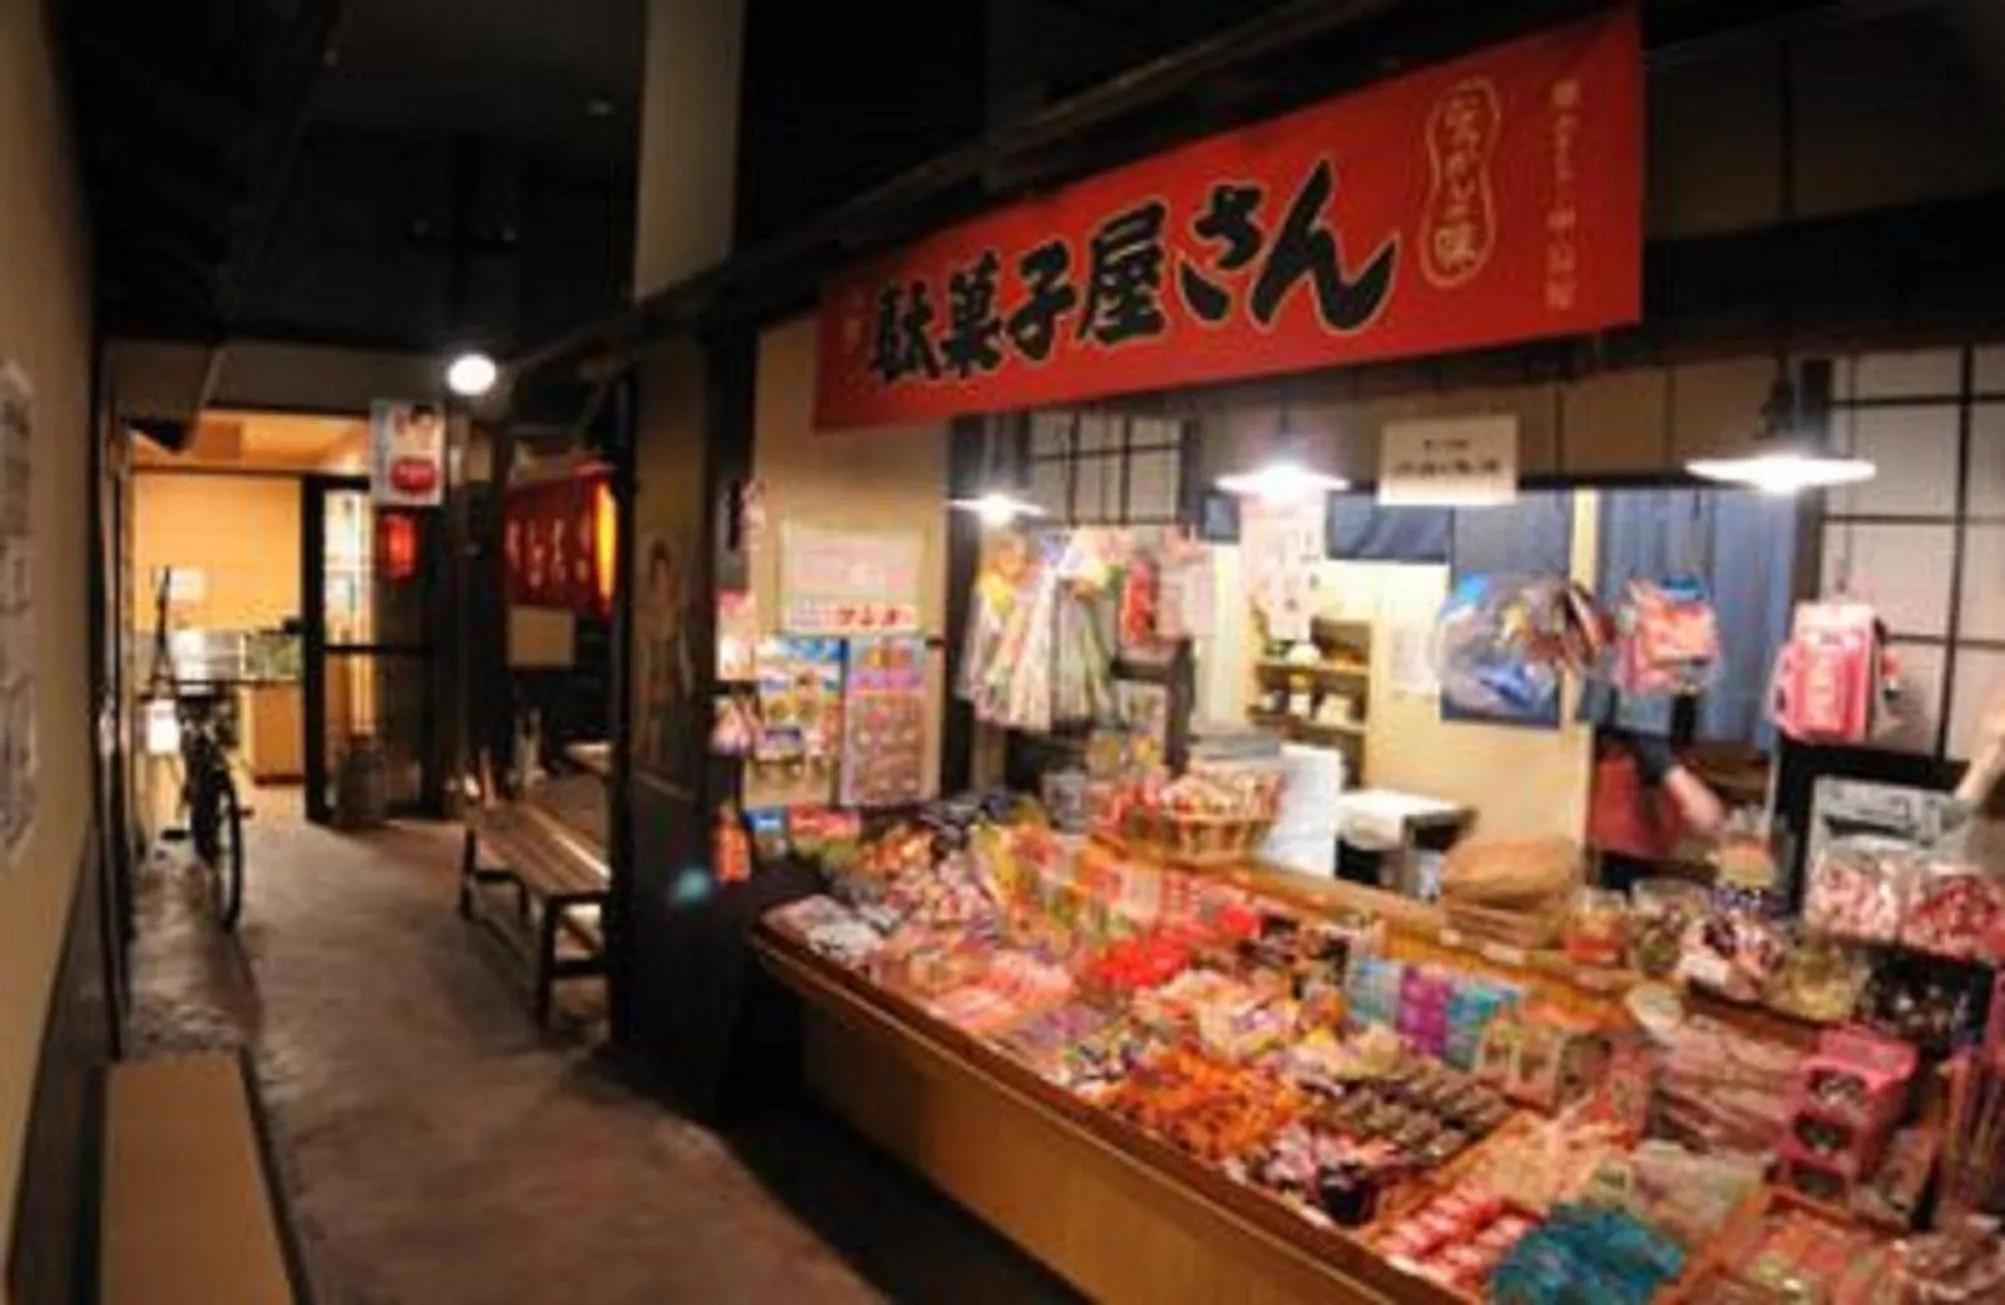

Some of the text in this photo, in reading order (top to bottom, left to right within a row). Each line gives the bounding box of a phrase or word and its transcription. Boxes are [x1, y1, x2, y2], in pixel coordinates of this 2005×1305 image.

[870, 158, 1398, 383] 駄菓子屋さん
